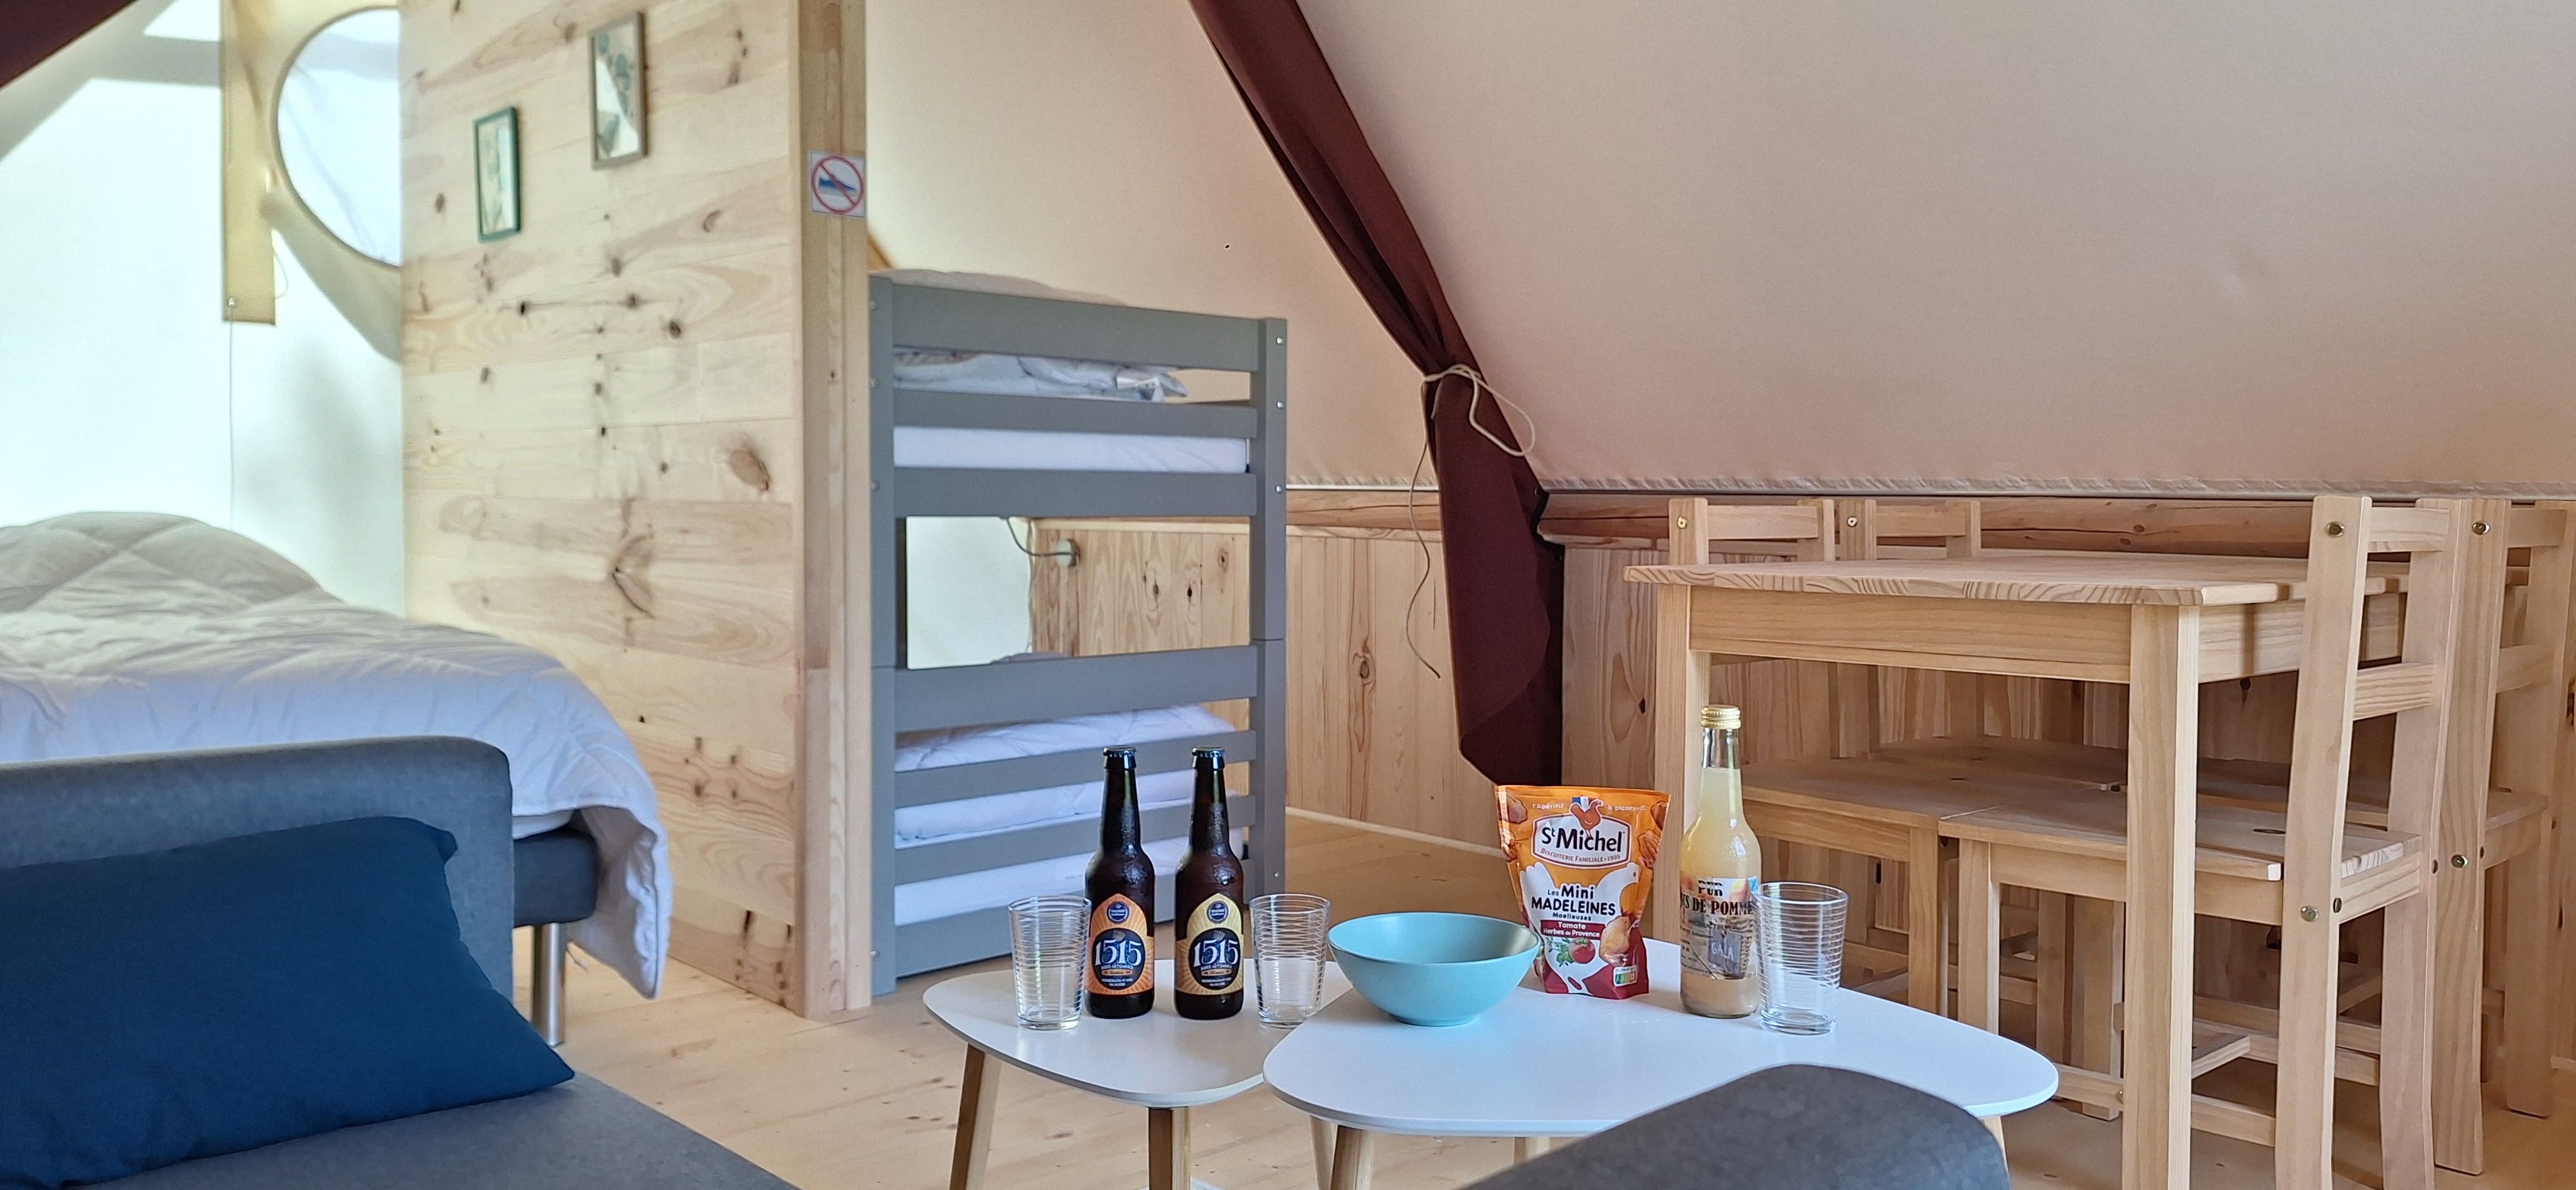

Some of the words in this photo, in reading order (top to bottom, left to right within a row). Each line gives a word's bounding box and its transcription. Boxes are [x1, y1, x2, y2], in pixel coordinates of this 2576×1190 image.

[1541, 848, 1575, 862] BISCUITERIE
[1575, 855, 1604, 863] FAMILIALE
[1561, 884, 1594, 900] Mini
[1531, 896, 1616, 916] MADELEINES
[1692, 897, 1707, 913] DE
[1552, 911, 1592, 922] Moelleuses
[1543, 928, 1565, 936] Herbes
[1571, 930, 1601, 938] Provence
[1558, 921, 1586, 930] Tomate
[1094, 939, 1142, 967] 1515
[1193, 939, 1239, 968] 1515
[1710, 941, 1734, 961] GALA
